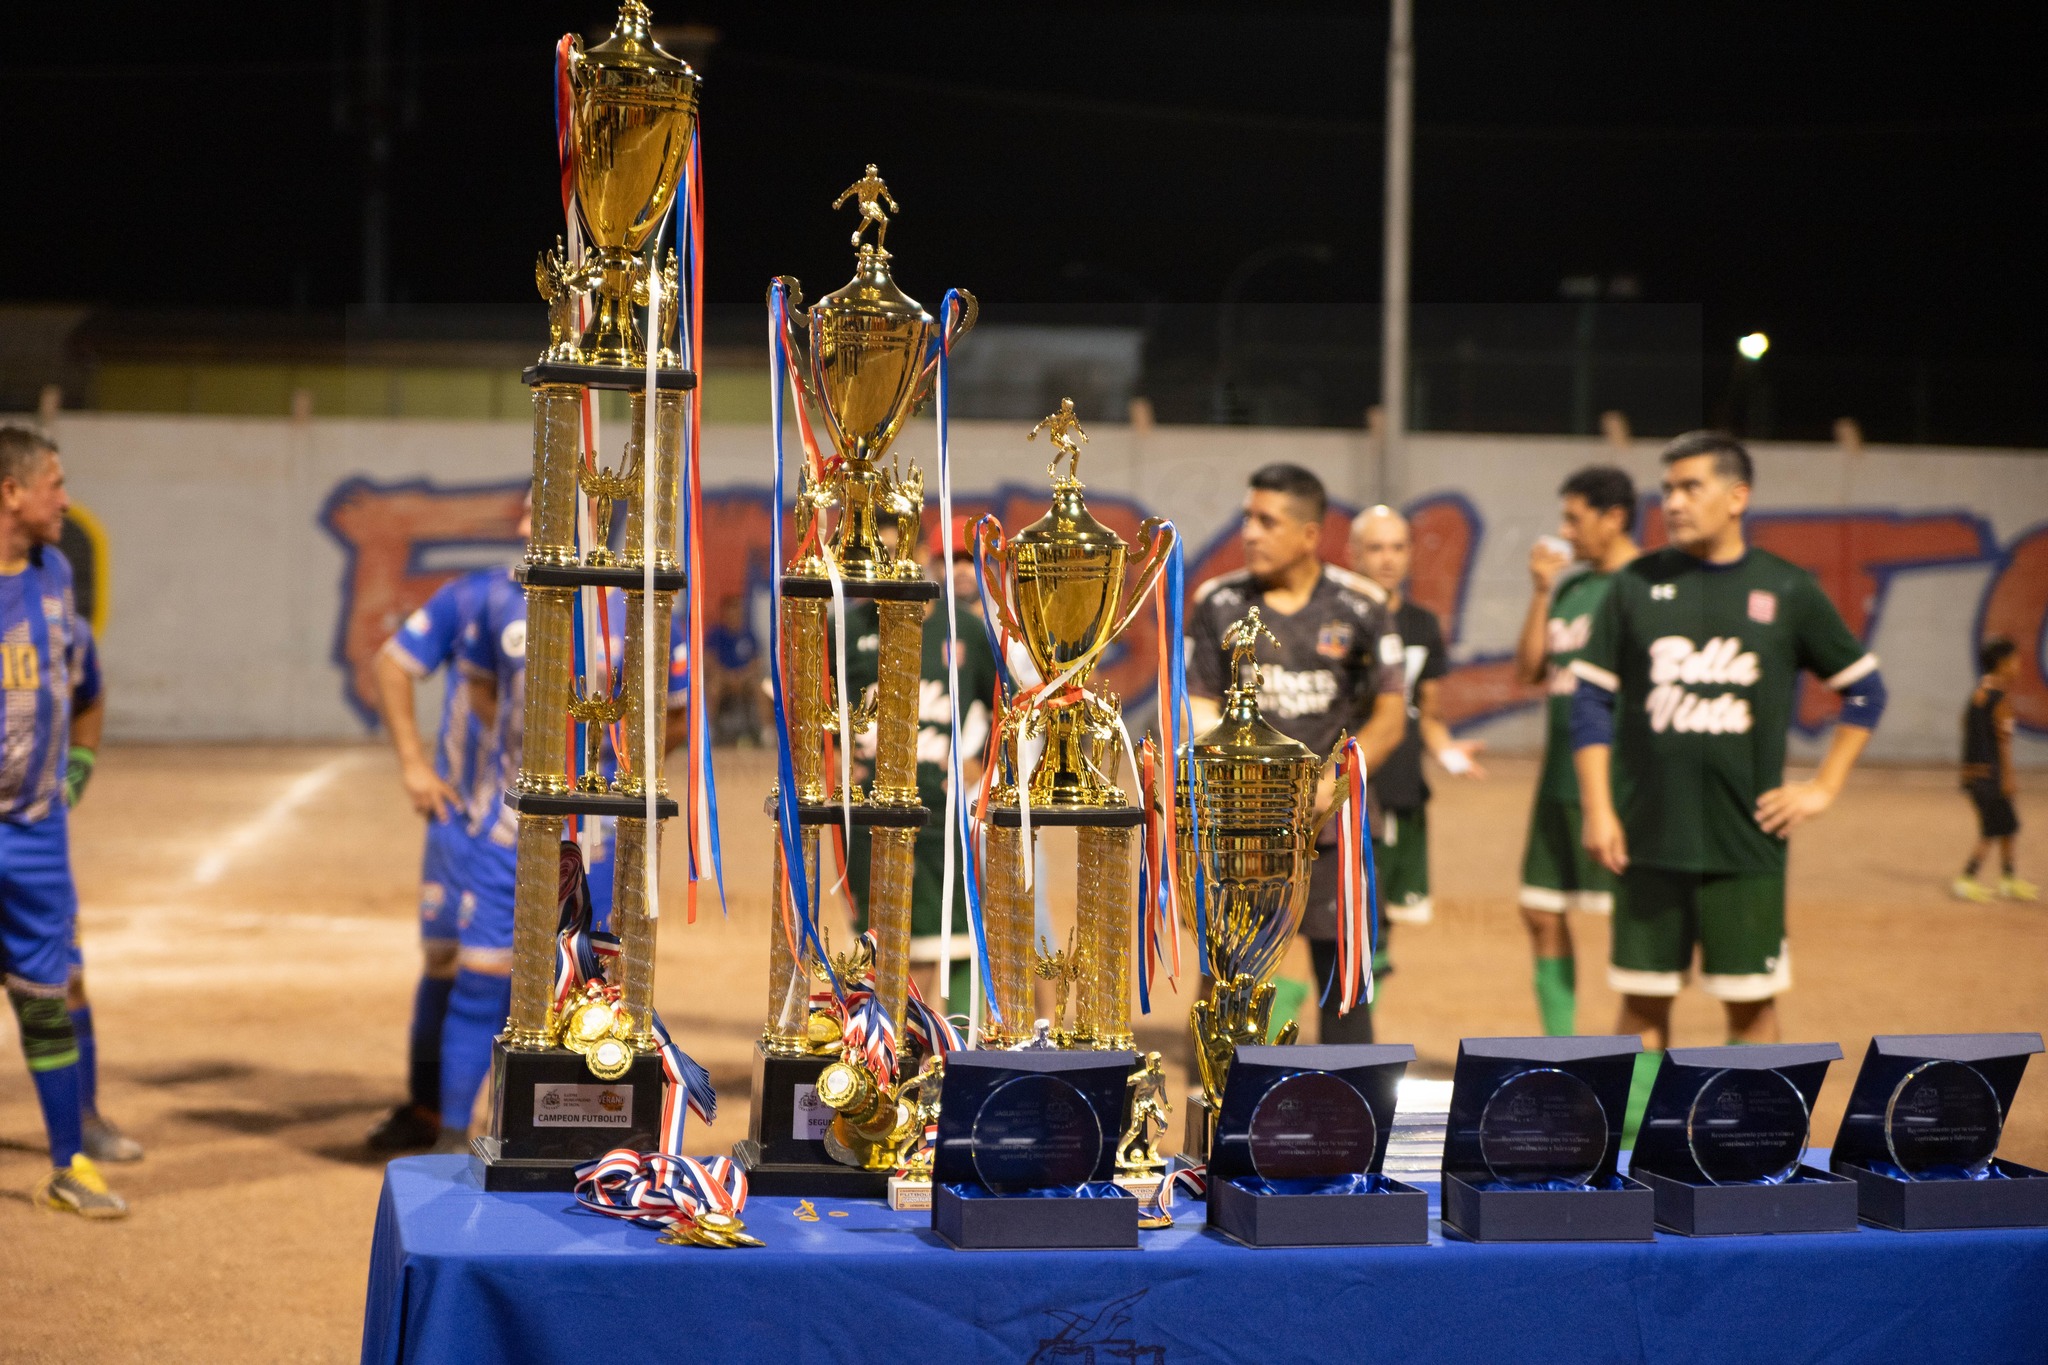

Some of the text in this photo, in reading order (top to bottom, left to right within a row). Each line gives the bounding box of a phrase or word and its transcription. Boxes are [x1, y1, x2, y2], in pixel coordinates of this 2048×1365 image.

[0, 643, 39, 690] 10
[1647, 635, 1761, 687] Bella
[1645, 684, 1754, 734] Vista
[538, 1114, 628, 1124] CAMPEON FUTBOLITO
